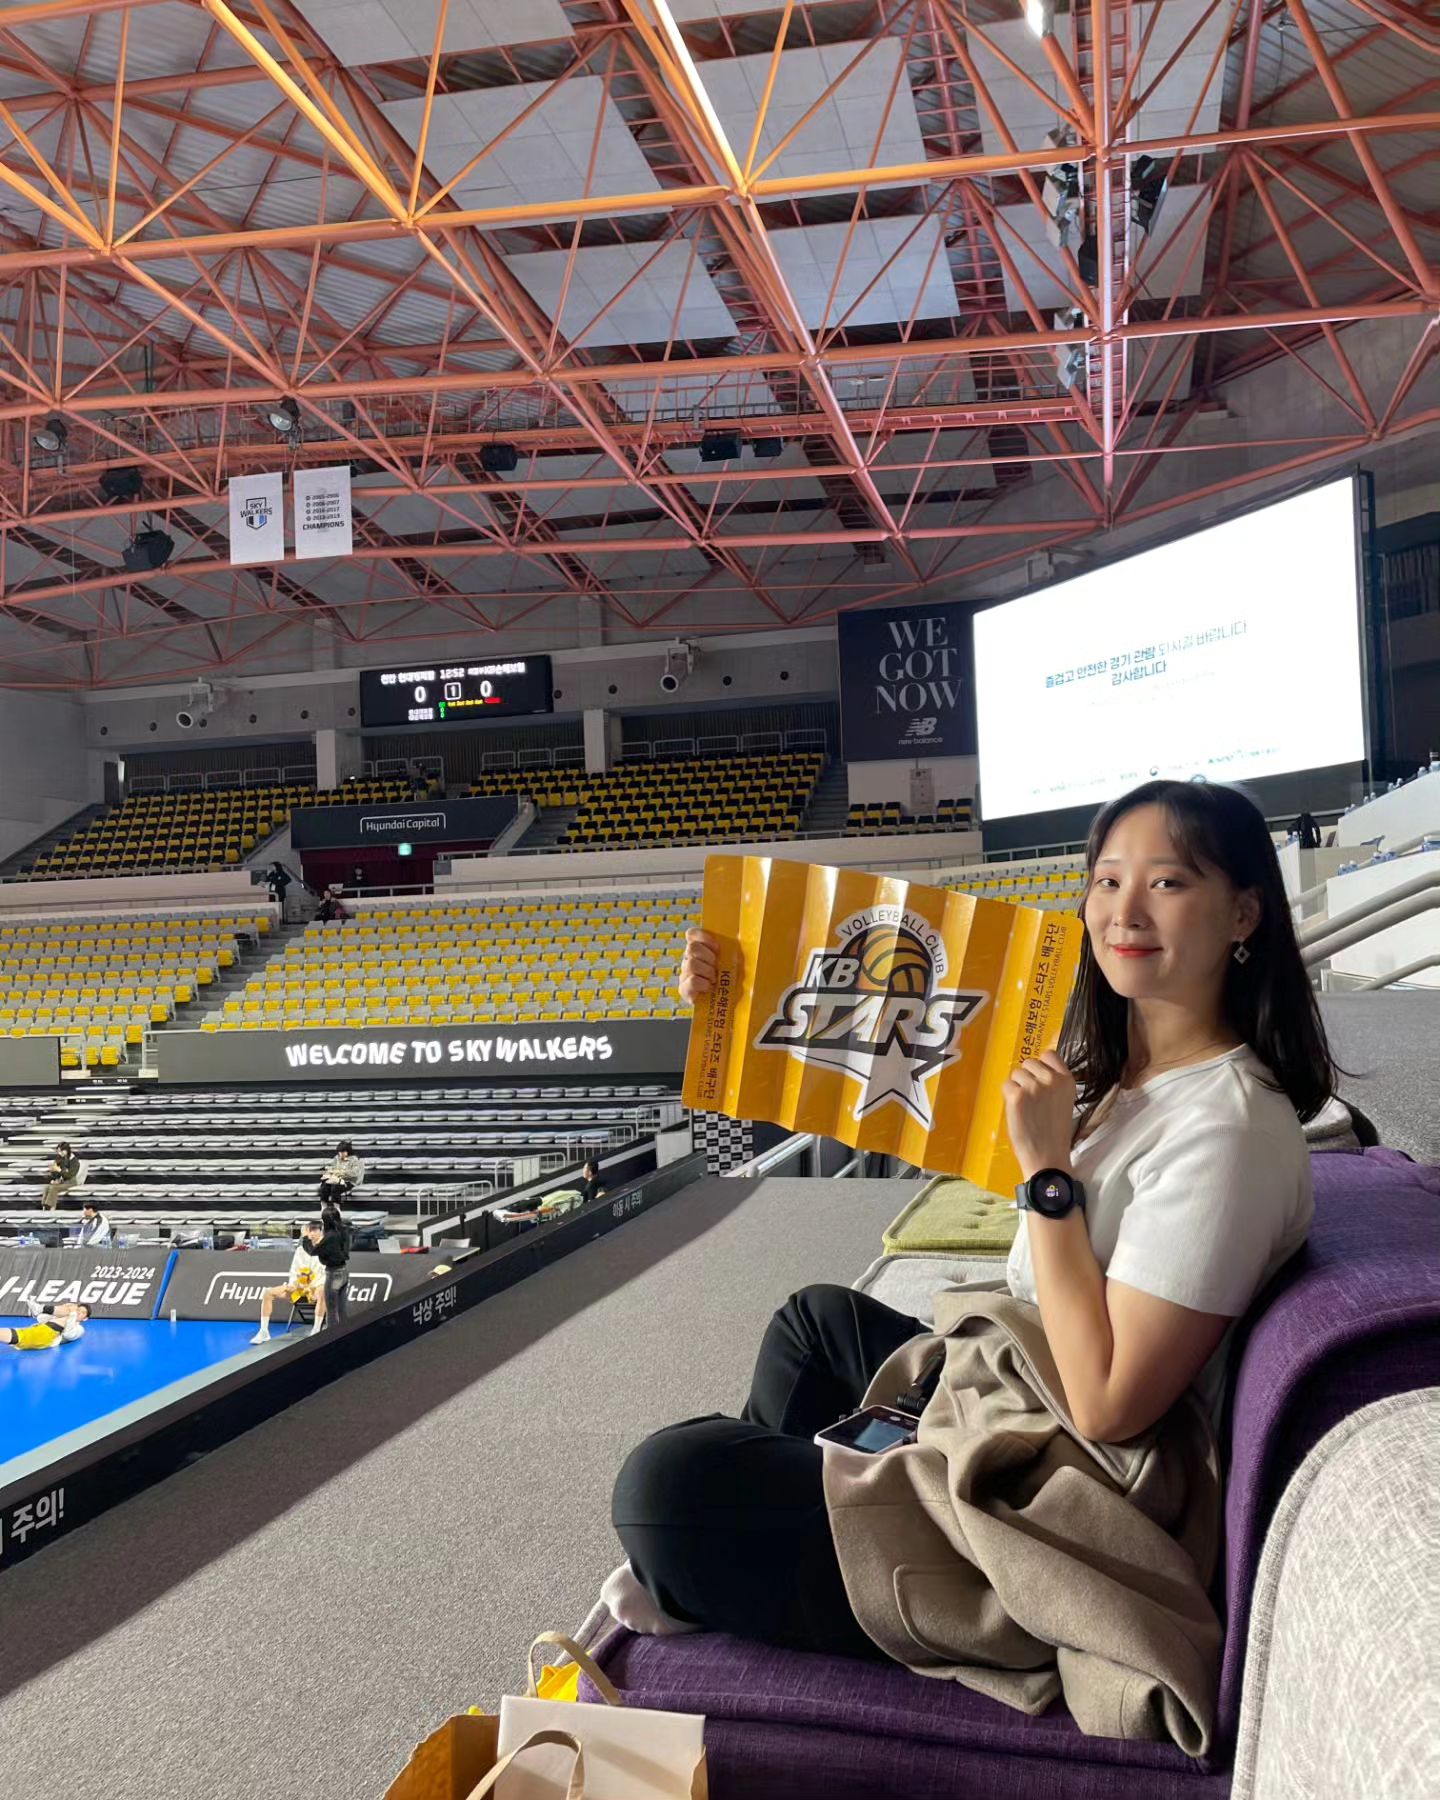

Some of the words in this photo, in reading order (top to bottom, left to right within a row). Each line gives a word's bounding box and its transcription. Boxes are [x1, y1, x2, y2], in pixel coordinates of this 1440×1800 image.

[240, 507, 273, 518] WALKERS
[249, 502, 263, 510] SKY
[302, 521, 345, 530] CHAMPIONS
[888, 617, 948, 649] WE
[879, 648, 958, 681] GOT
[1110, 653, 1131, 670] 경기
[1133, 646, 1156, 663] 관람
[1112, 660, 1167, 686] 감사합니다
[414, 686, 427, 703] 0
[480, 680, 493, 698] 0
[876, 680, 962, 714] NOW
[366, 819, 405, 832] Hyundai
[406, 817, 440, 830] Capital
[841, 909, 925, 937] VOLLEYBALL
[924, 935, 944, 974] CLUB
[1041, 924, 1060, 958] 배구단
[806, 957, 860, 988] KB
[1033, 962, 1050, 996] 스타즈
[1042, 989, 1053, 1012] STARS
[1049, 947, 1064, 989] VOLLEYBALL
[1058, 926, 1067, 945] CLUB
[713, 970, 731, 1029] KB손해보험
[767, 991, 977, 1048] STARS
[1019, 998, 1042, 1064] KB손해보험
[285, 1041, 407, 1067] WELCOME
[411, 1040, 442, 1064] TO
[709, 1032, 723, 1064] 스타즈
[703, 1067, 718, 1100] 배구단
[90, 1266, 156, 1280] 2023-2024
[412, 1297, 433, 1325] 낙상
[434, 1285, 457, 1314] 주의!
[11, 1487, 65, 1544] 주의!
